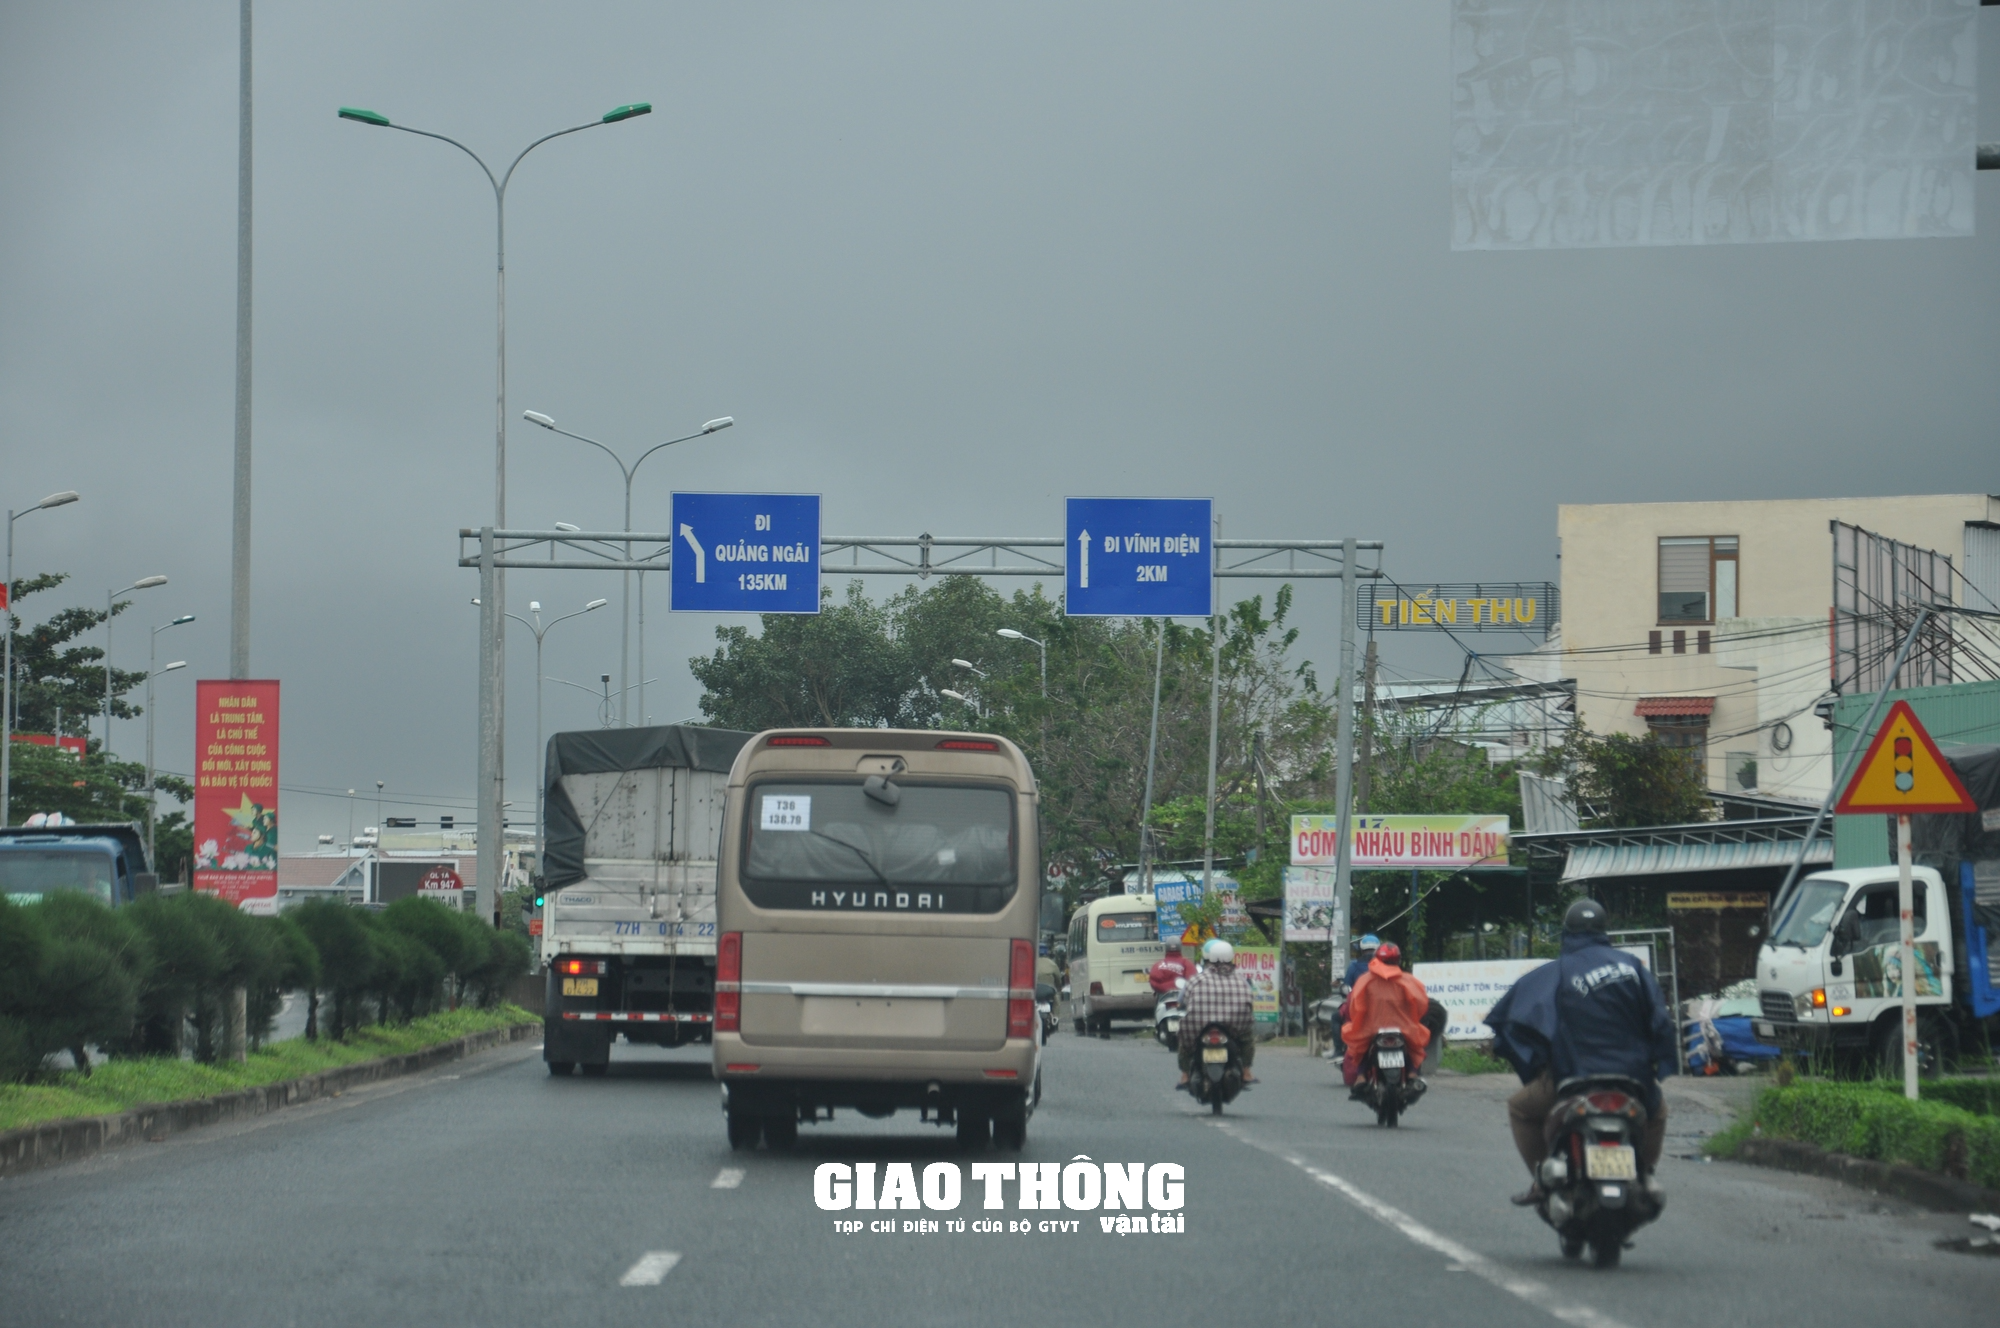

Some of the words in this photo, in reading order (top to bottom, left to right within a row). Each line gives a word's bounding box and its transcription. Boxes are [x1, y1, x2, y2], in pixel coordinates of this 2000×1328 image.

[755, 514, 771, 531] ĐI
[715, 539, 769, 562] QUẢNG
[772, 542, 810, 562] NGÃI
[1104, 536, 1120, 552] ĐI
[1124, 533, 1160, 553] VĨNH
[1164, 533, 1200, 556] ĐIỆN
[738, 573, 787, 591] 135KM
[1136, 565, 1168, 582] 2KM
[1376, 588, 1457, 624] TIẾN
[1466, 598, 1537, 624] THU
[218, 696, 240, 708] NHÂN
[241, 696, 258, 708] DÂN
[209, 712, 220, 724] LÀ
[221, 713, 246, 724] TRUNG
[216, 727, 227, 739] LÀ
[224, 743, 245, 755] CÔNG
[1298, 829, 1337, 857] CƠM
[1356, 826, 1405, 863] NHẬU
[1411, 826, 1454, 857] BÌNH
[1460, 826, 1498, 857] DÂN
[441, 872, 450, 880] 1A
[424, 881, 439, 890] Km
[440, 880, 456, 890] 947
[811, 890, 944, 909] HYUNDAI
[614, 921, 641, 935] 77H
[698, 922, 715, 936] 22
[1261, 950, 1275, 970] GÀ
[1474, 982, 1491, 992] TÔN
